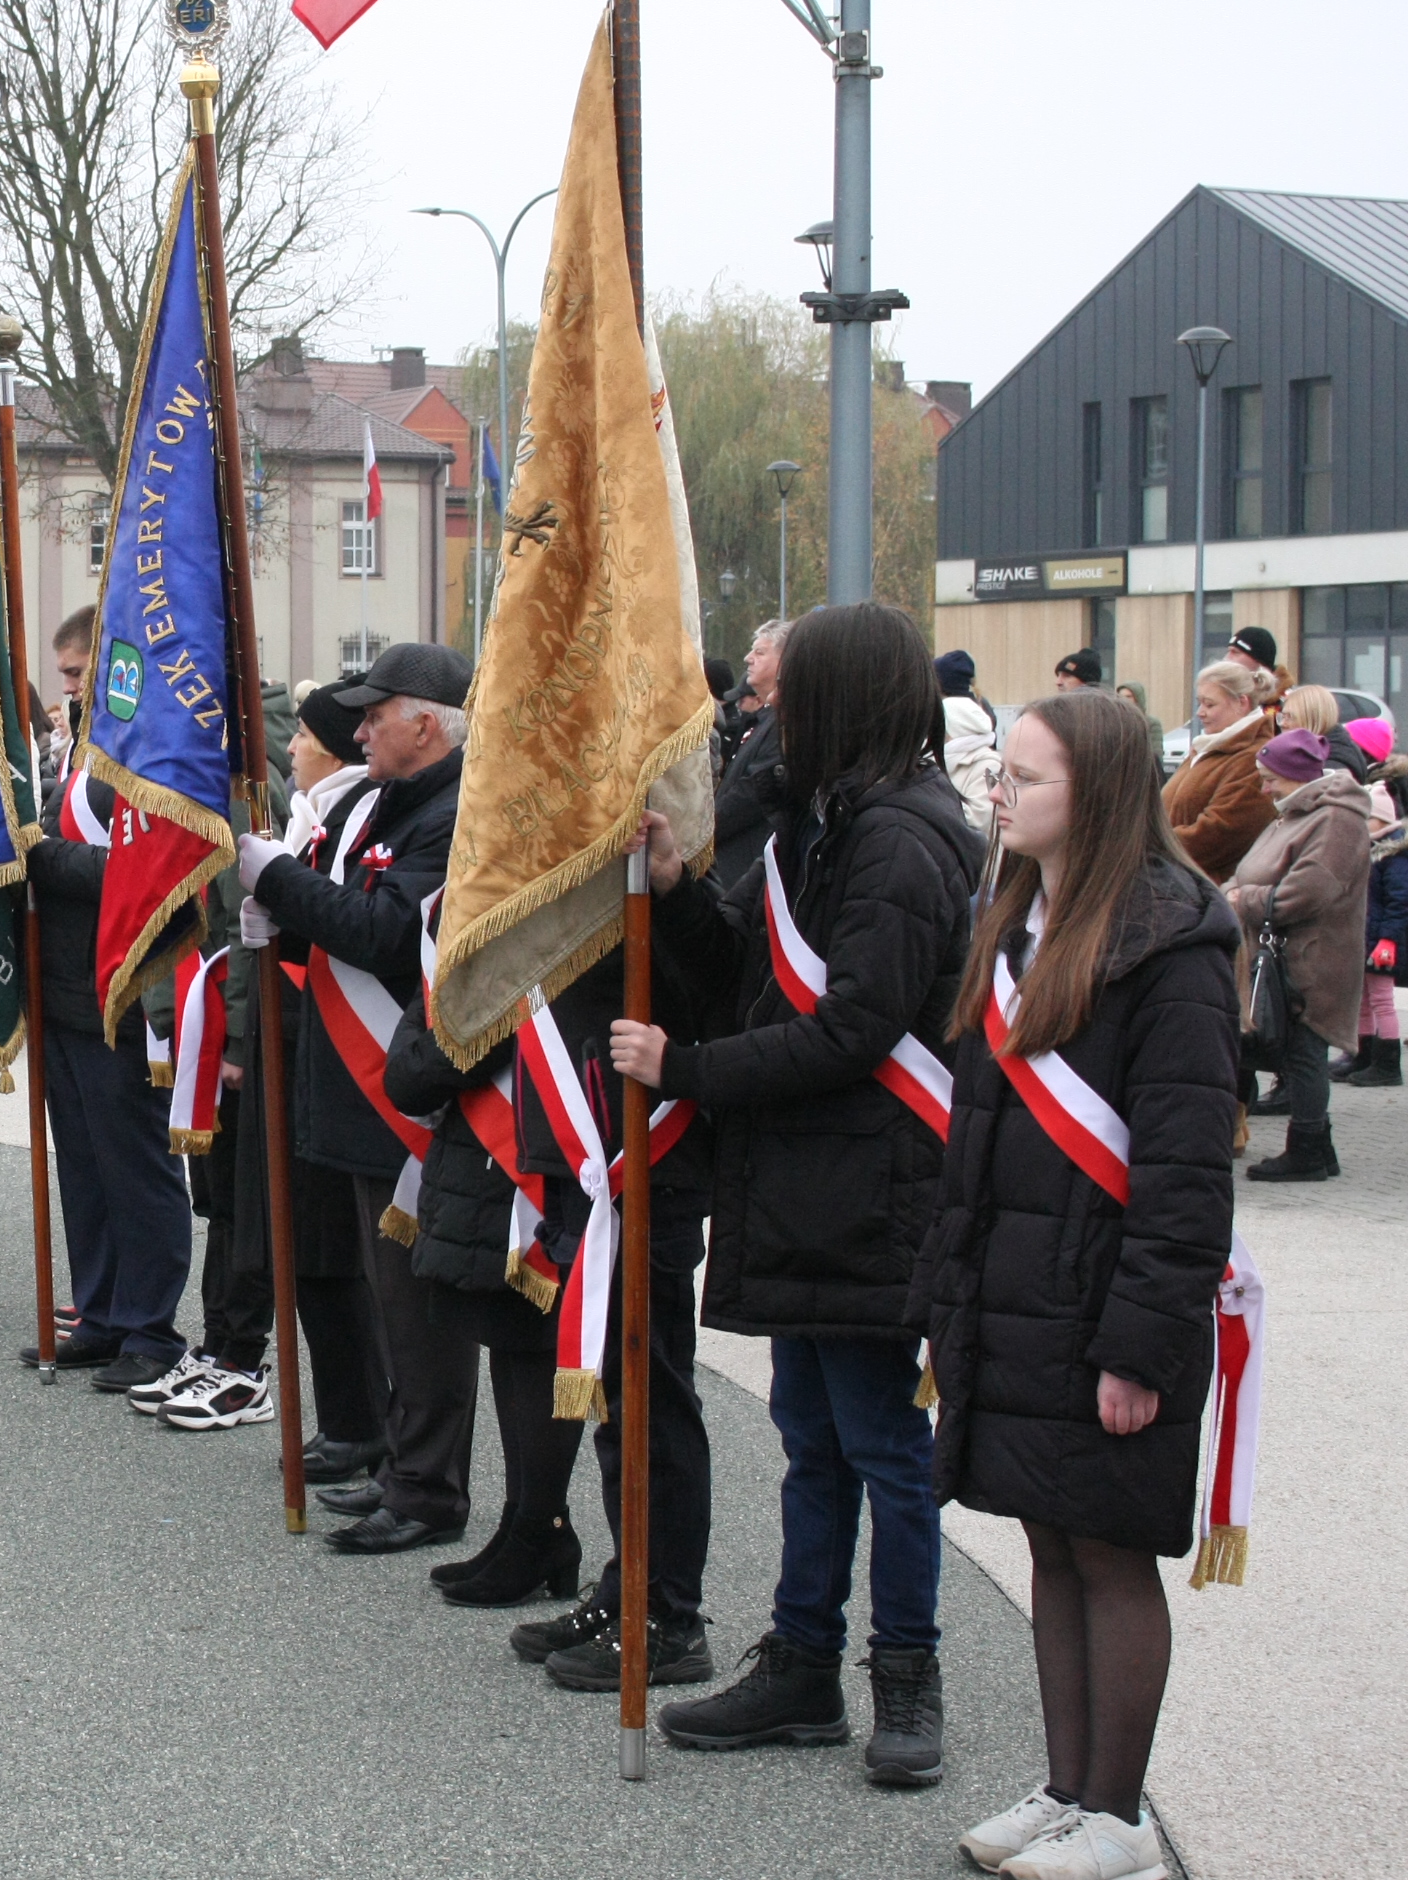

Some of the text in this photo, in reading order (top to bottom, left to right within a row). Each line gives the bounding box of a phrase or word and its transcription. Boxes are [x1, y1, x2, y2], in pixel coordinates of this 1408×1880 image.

[978, 566, 1103, 582] SHAKE ALKOHOLE
[976, 581, 1006, 591] PRESTIGE
